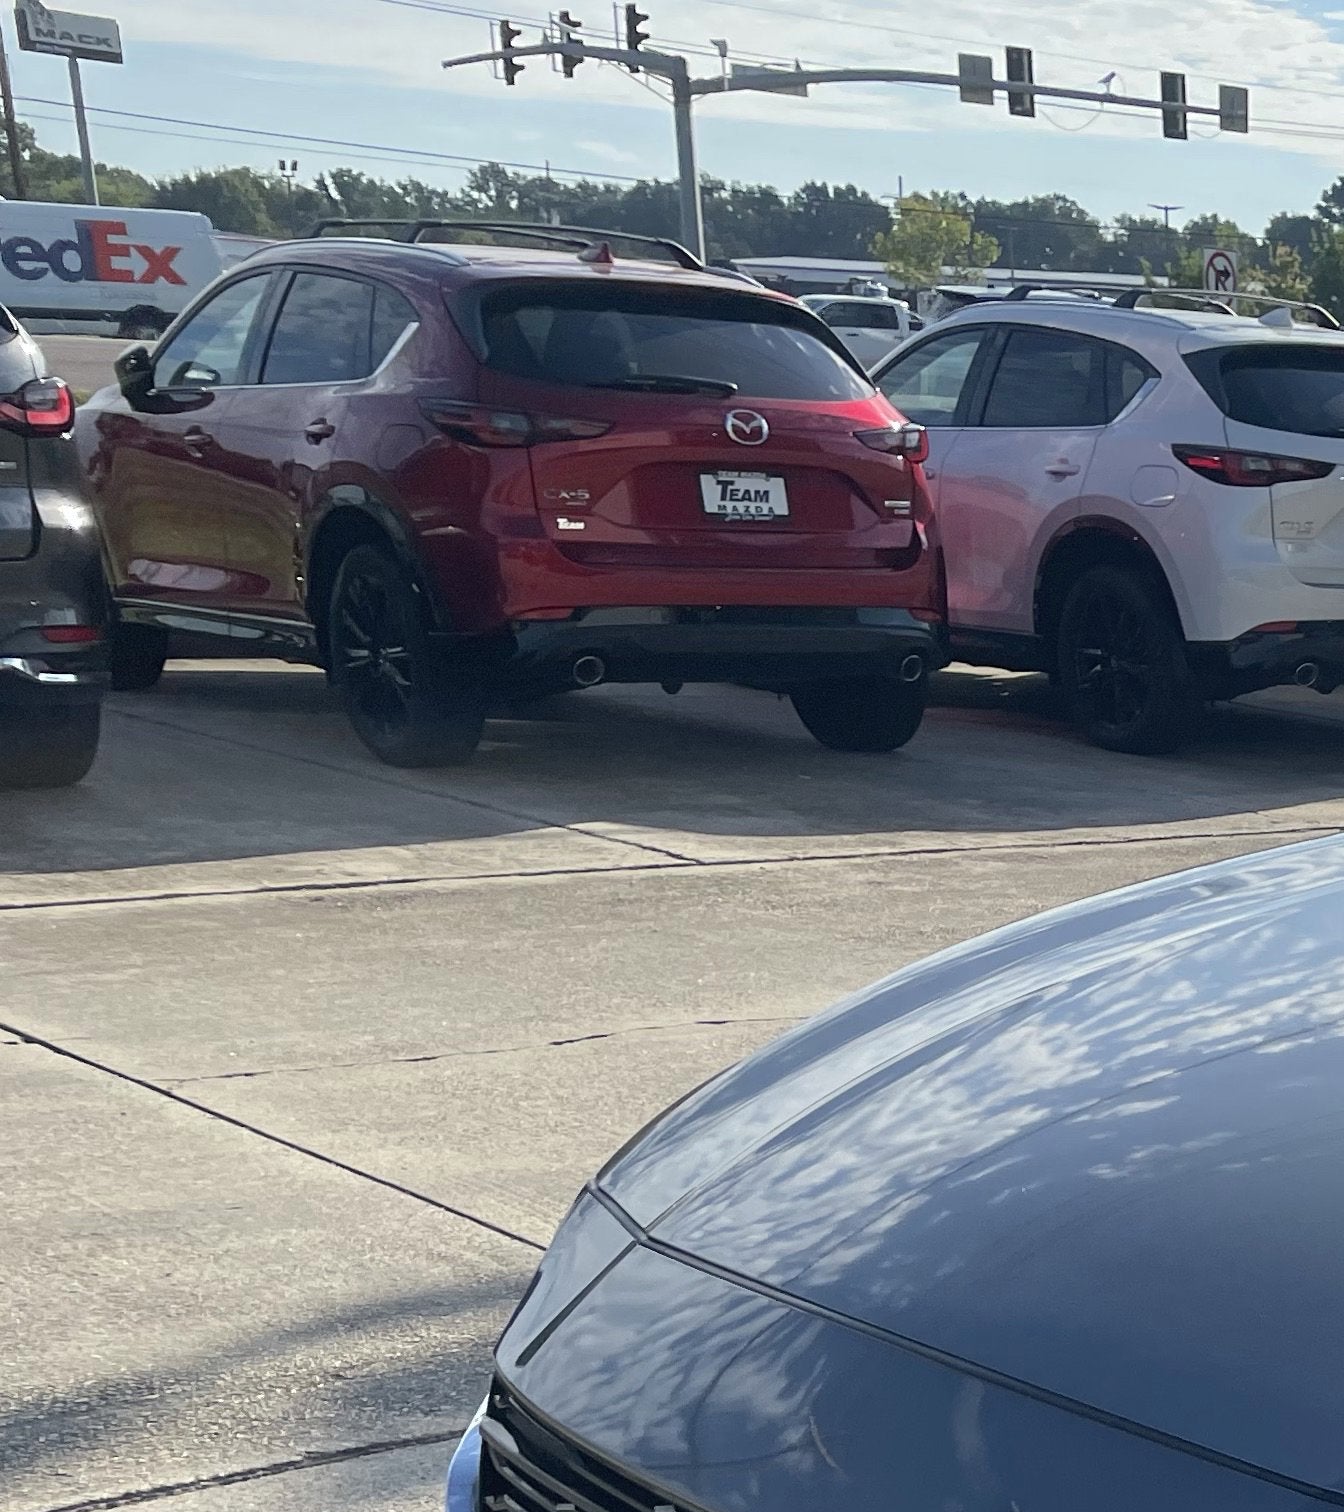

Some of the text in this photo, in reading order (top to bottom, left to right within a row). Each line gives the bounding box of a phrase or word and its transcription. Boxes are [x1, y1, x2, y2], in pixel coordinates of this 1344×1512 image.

[35, 27, 113, 47] MACK
[0, 219, 188, 286] edEx
[716, 480, 770, 503] TEAM
[717, 504, 775, 513] MAZDA
